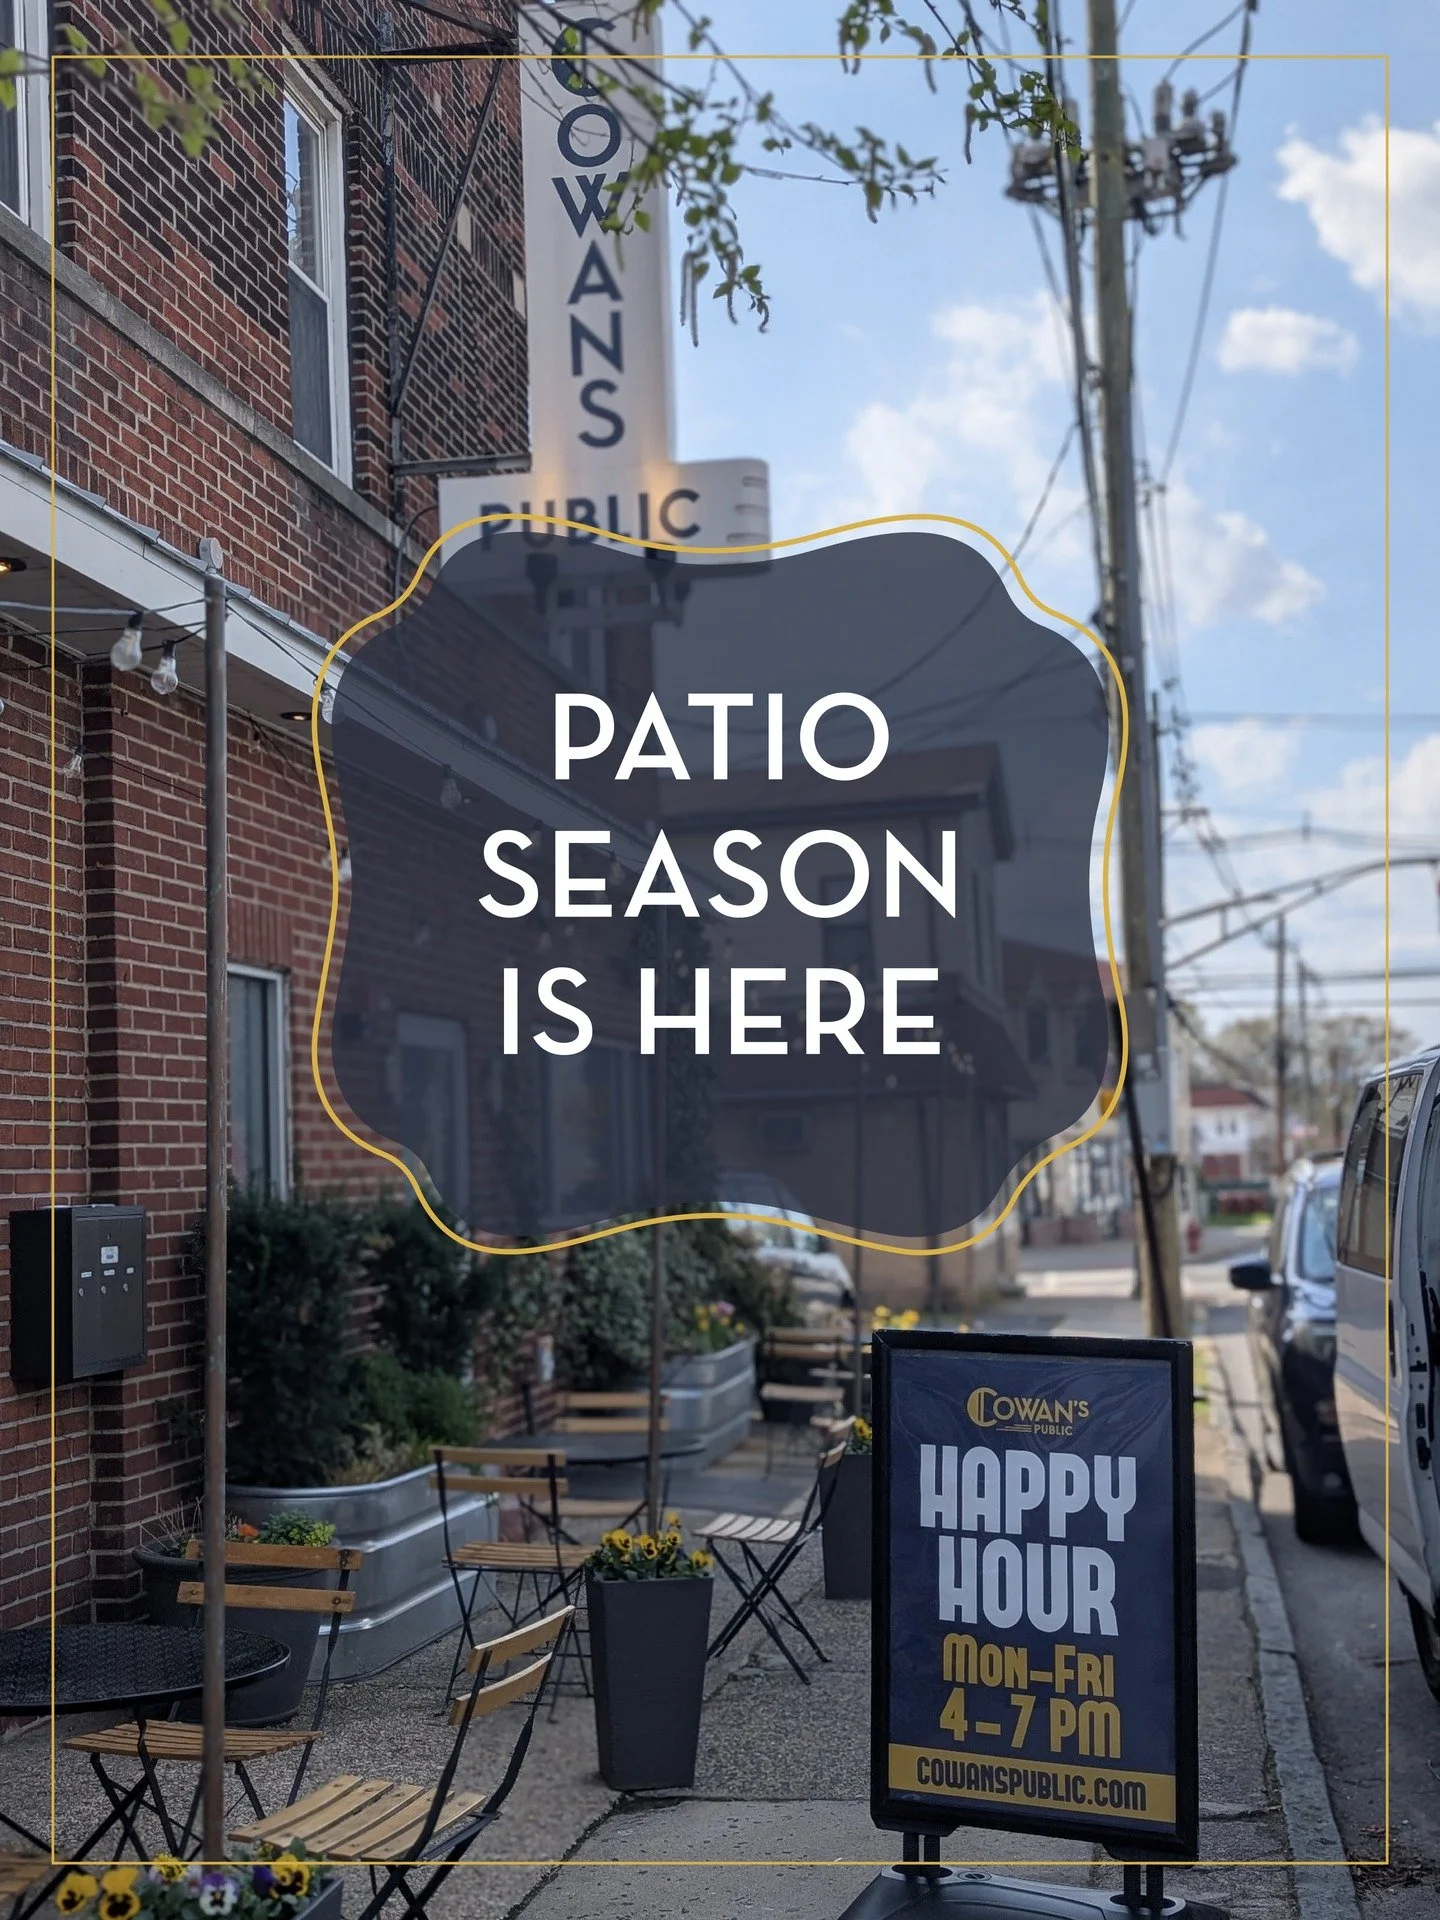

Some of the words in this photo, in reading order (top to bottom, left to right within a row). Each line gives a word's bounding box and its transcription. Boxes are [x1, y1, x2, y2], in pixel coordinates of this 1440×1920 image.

[551, 17, 630, 448] COWANS
[480, 488, 701, 552] PUBLIC
[967, 1387, 1089, 1427] COWAN'S
[1034, 1425, 1073, 1436] PUBLIC
[919, 1443, 1137, 1542] HAPPY
[938, 1535, 1119, 1636] HOUR
[1050, 1698, 1121, 1759] PM
[917, 1756, 1147, 1812] COWANSPUBLIC.COM
